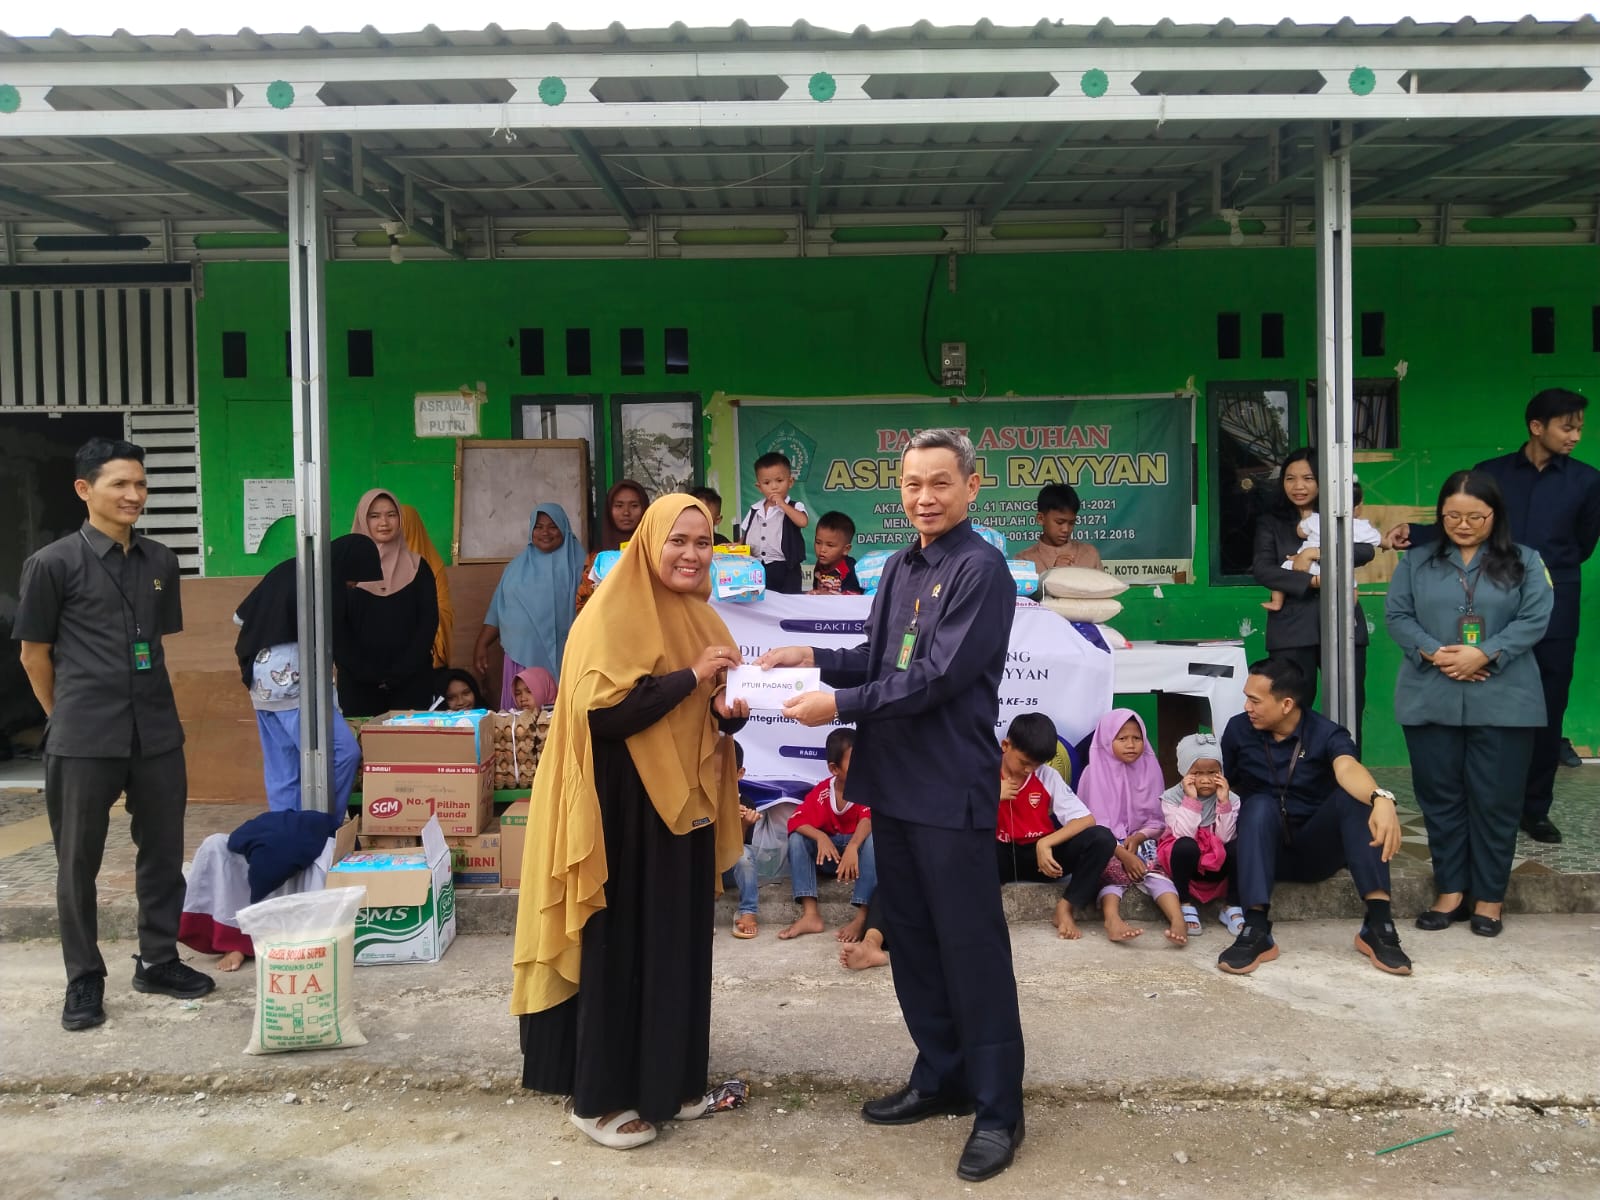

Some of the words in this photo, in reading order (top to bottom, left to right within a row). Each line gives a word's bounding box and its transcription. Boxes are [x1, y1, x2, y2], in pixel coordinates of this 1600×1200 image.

[420, 400, 470, 411] ASRAMA
[430, 420, 465, 431] PUTRI
[977, 426, 1111, 450] ASUHAN
[1008, 453, 1168, 486] RAYYAN
[968, 502, 980, 512] O.
[984, 502, 996, 512] 41
[1000, 501, 1039, 511] TANGG
[1080, 500, 1116, 510] 1-2021
[1075, 515, 1107, 525] 31271
[857, 534, 902, 544] DAFTAR
[1115, 566, 1139, 575] KOTO
[1142, 565, 1177, 574] TANGAH
[814, 623, 850, 631] BAKTI
[1006, 651, 1031, 662] NG
[1004, 668, 1049, 680] YYAN
[741, 681, 760, 689] PTUN
[762, 682, 793, 690] PADANG
[1006, 697, 1038, 705] KE-35
[372, 801, 399, 814] SGM
[437, 801, 470, 809] Pilihan
[455, 854, 496, 867] MURNI
[306, 962, 323, 970] OLEH
[268, 973, 323, 995] KIA
